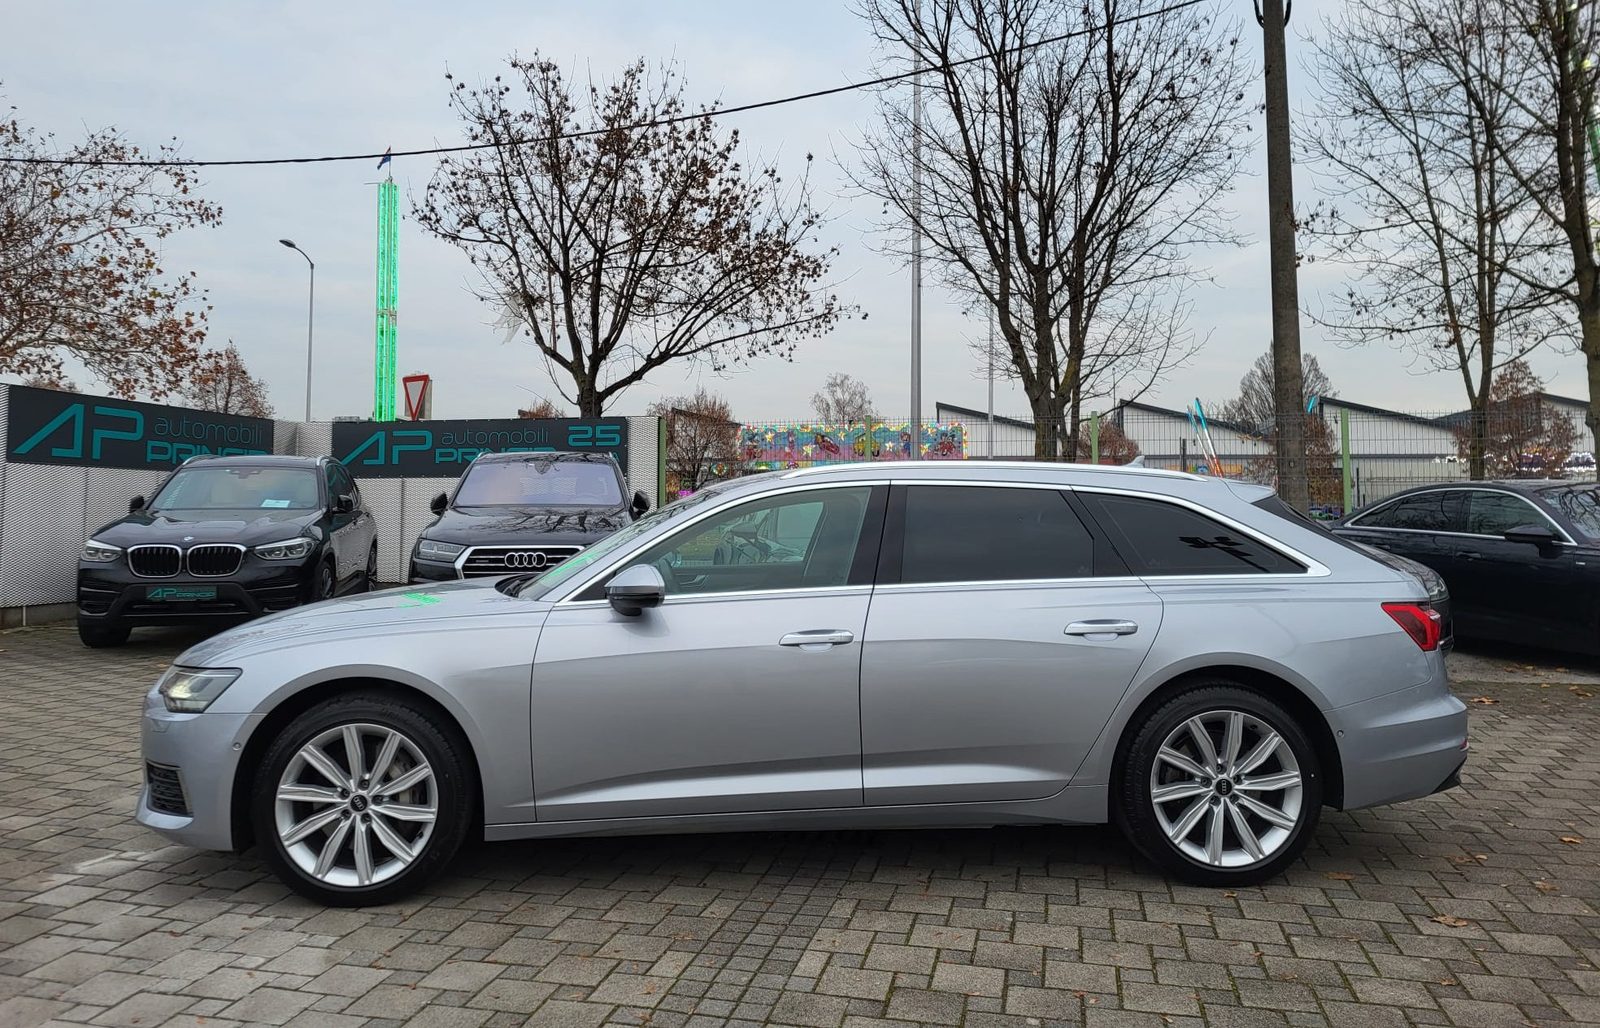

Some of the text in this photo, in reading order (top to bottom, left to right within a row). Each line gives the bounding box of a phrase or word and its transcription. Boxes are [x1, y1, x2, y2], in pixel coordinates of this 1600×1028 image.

[12, 403, 145, 460] AP
[154, 416, 264, 445] automobili
[441, 427, 550, 445] automobili
[567, 425, 621, 447] 25
[340, 430, 433, 465] AP
[148, 588, 177, 598] AP
